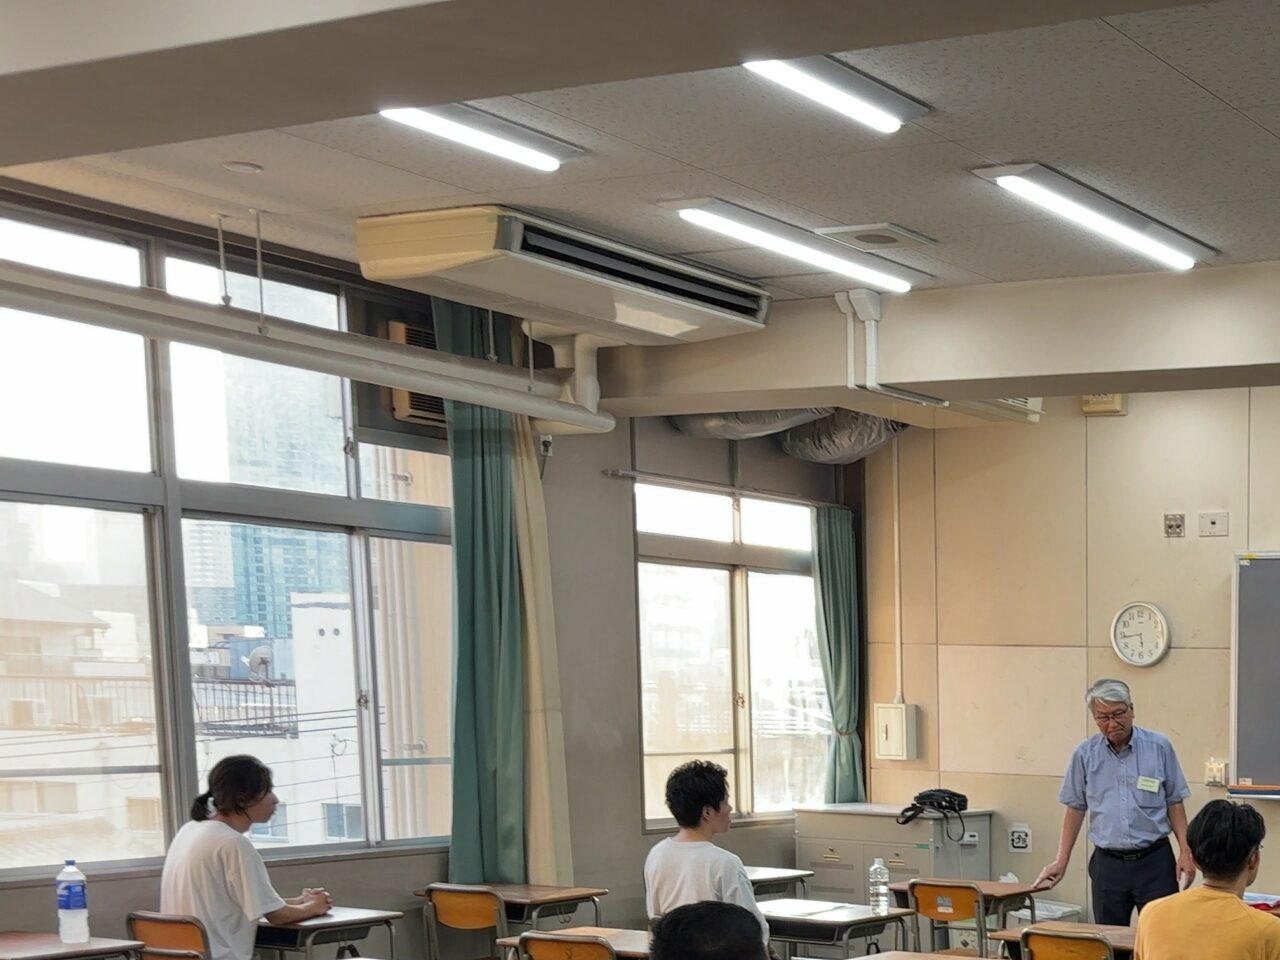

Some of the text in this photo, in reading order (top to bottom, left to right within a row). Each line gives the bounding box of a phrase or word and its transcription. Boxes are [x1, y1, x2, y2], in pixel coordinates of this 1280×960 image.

[1128, 612, 1135, 621] 11
[1136, 610, 1145, 619] 12
[1122, 620, 1130, 629] 10
